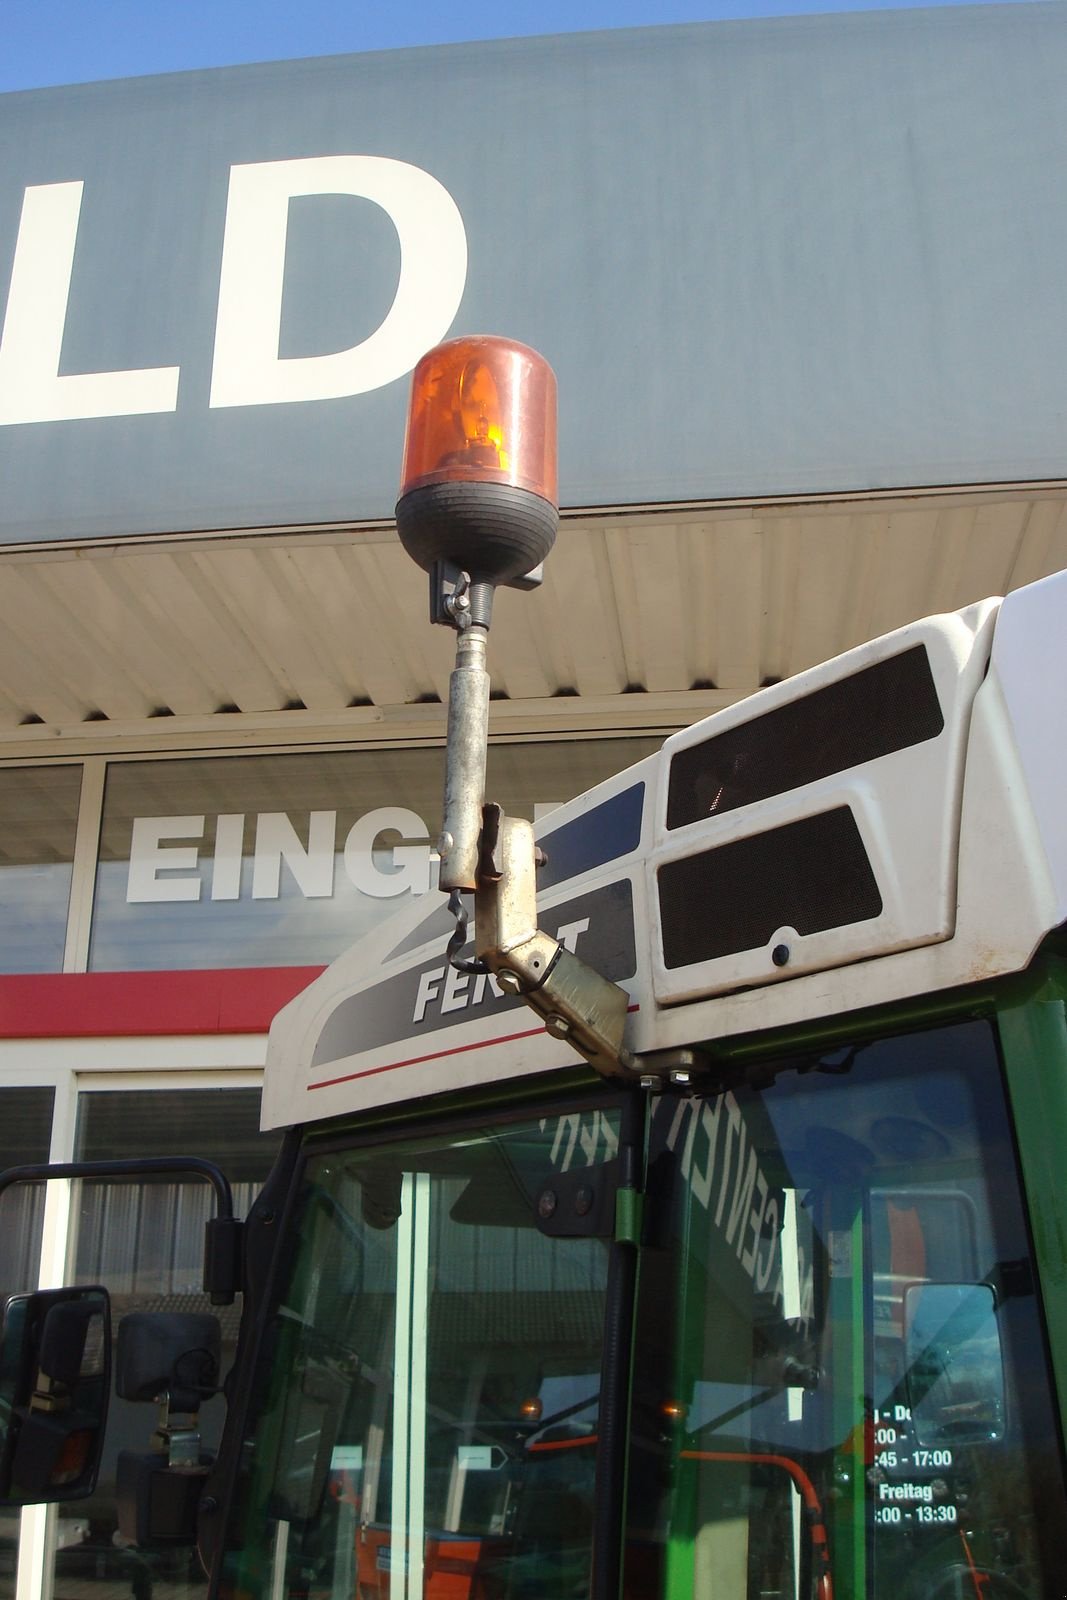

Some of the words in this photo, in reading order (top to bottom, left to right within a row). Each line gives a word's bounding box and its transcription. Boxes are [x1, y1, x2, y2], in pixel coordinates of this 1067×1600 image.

[127, 803, 566, 902] EING
[413, 918, 590, 1022] FENT
[912, 1450, 952, 1466] 17:00
[879, 1483, 933, 1501] Freitag
[874, 1506, 901, 1523] :00
[915, 1505, 957, 1521] 13:30
